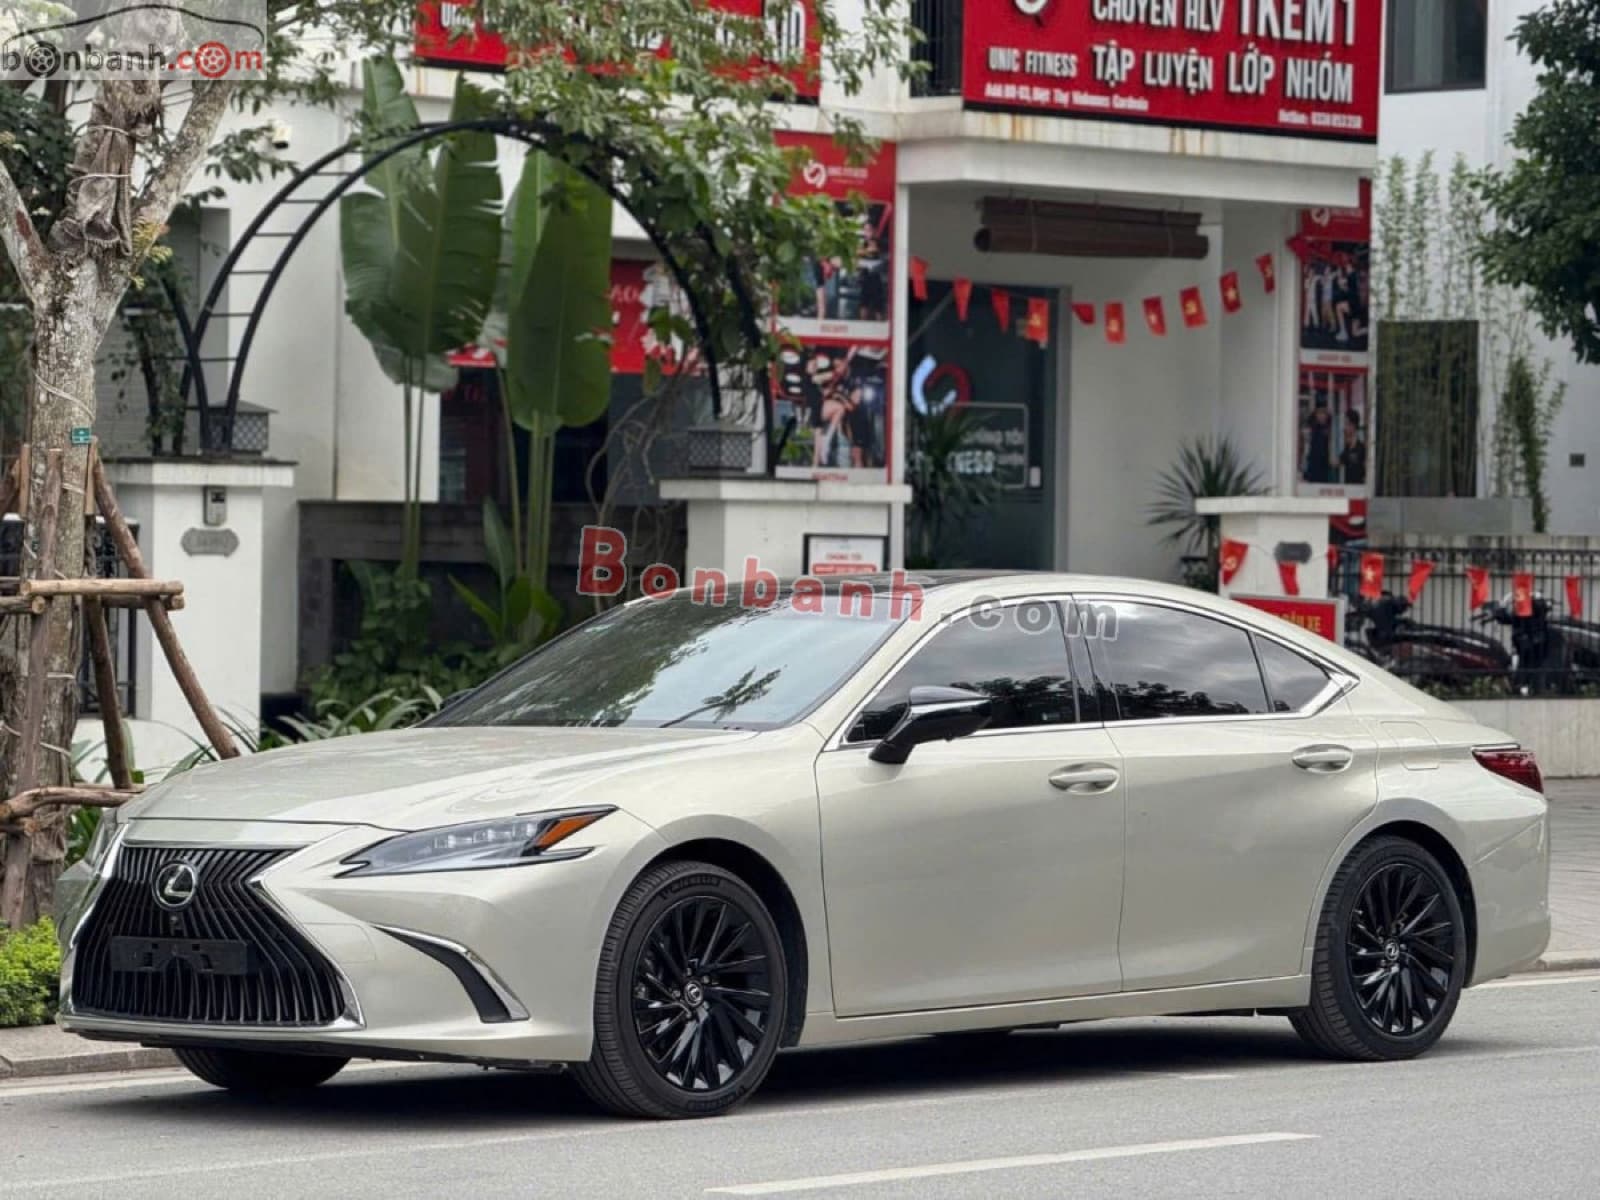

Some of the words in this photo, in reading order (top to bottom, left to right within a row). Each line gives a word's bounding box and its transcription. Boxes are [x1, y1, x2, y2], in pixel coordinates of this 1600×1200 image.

[1185, 0, 1224, 32] HLV
[988, 46, 1021, 73] UNIC
[1025, 50, 1079, 78] FITNESS
[1092, 39, 1136, 88] TẬP
[1144, 47, 1214, 96] LUYỆN
[1227, 41, 1276, 96] LỚP
[1285, 51, 1354, 104] NHÓM
